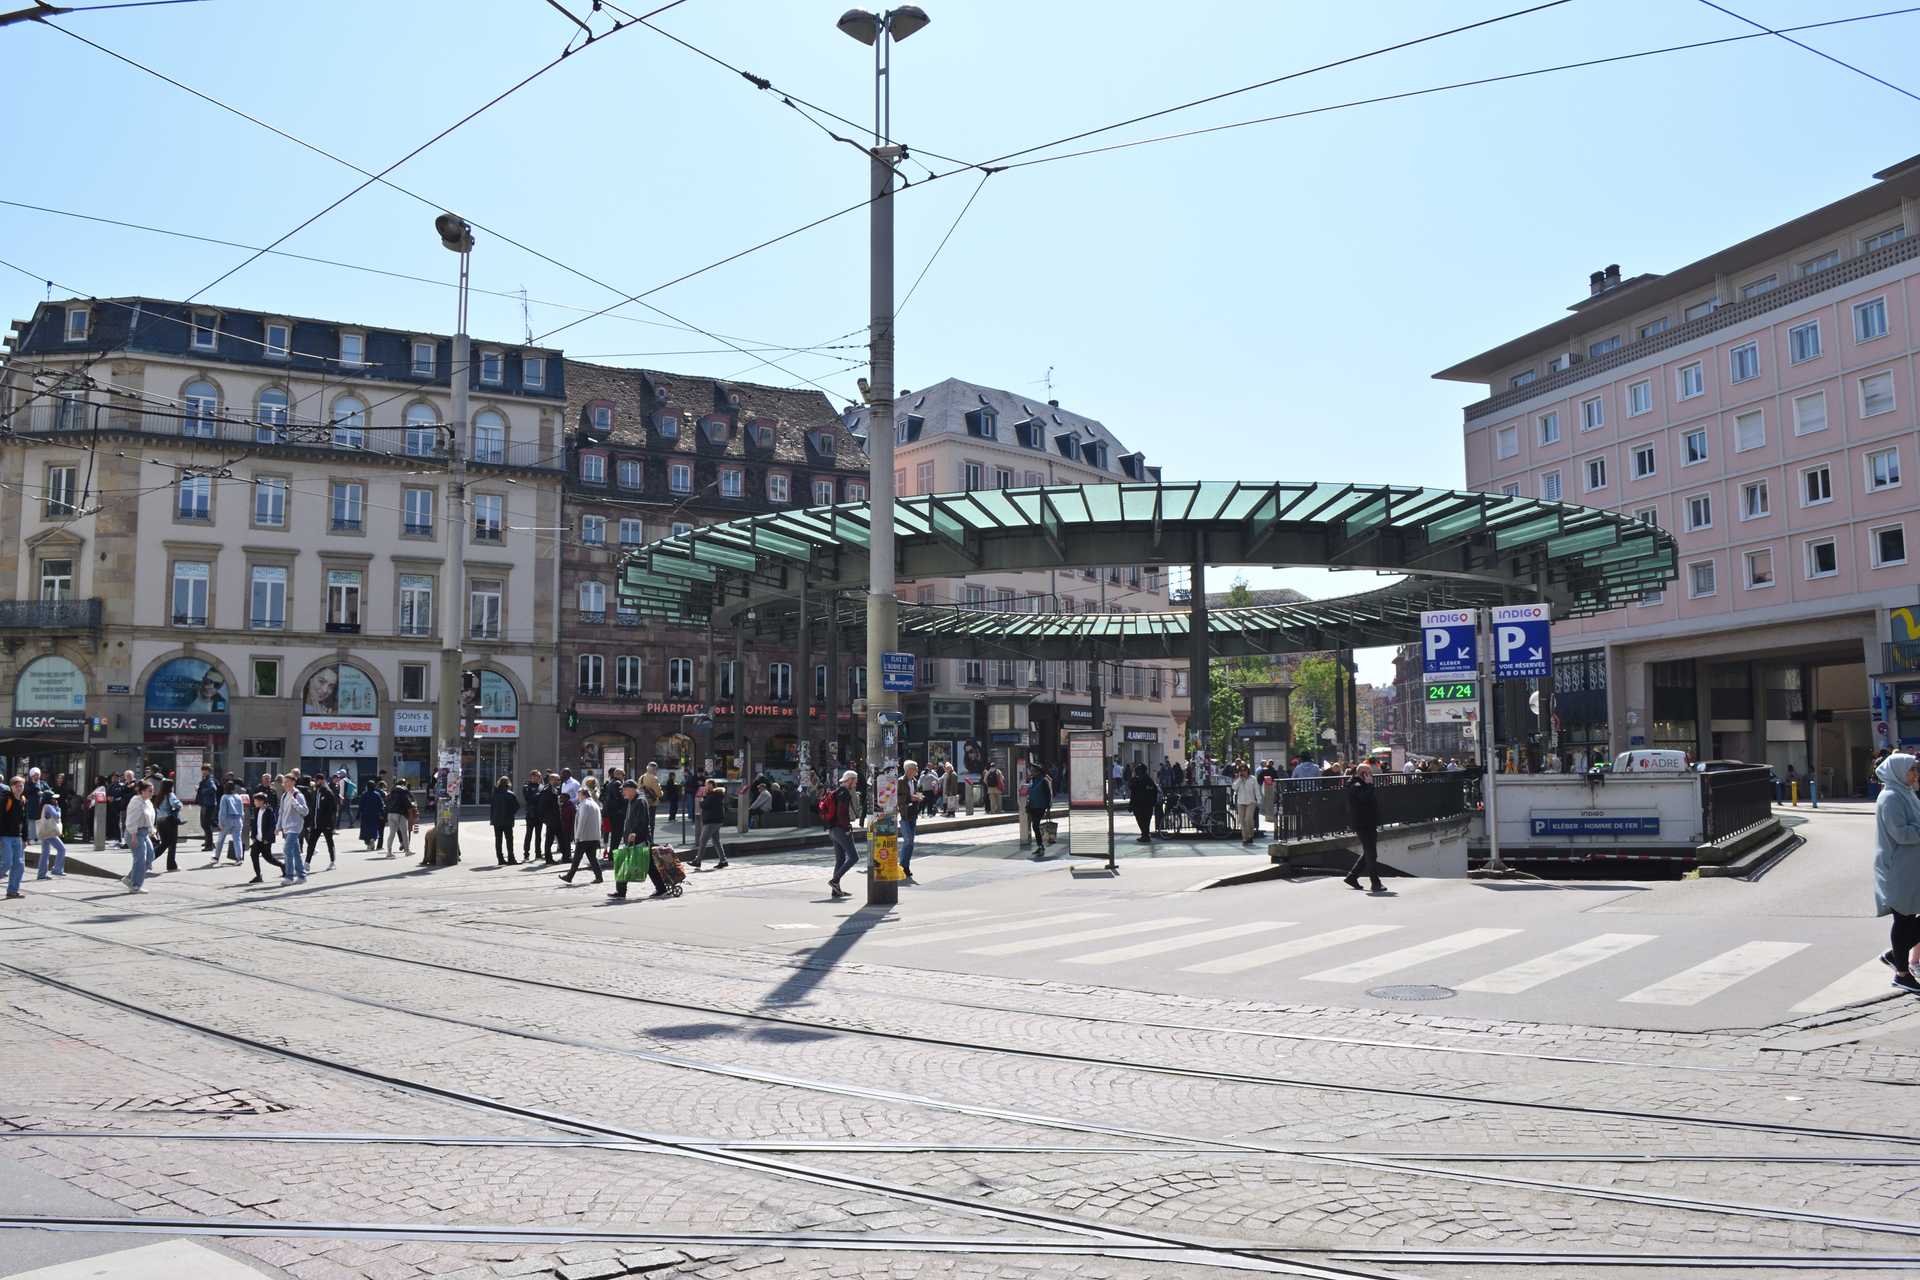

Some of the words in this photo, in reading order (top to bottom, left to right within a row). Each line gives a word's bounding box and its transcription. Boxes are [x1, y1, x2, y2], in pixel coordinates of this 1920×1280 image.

[1427, 613, 1468, 624] INDIGO
[1499, 608, 1541, 619] INDIGO
[1426, 628, 1451, 661] P
[1498, 626, 1526, 662] P
[1499, 668, 1546, 677] ABONNÉS
[396, 712, 421, 720] SOINS
[16, 717, 55, 728] LISSAC
[150, 718, 197, 729] LISSAC
[1651, 759, 1679, 769] ADRE
[1535, 821, 1545, 833] P
